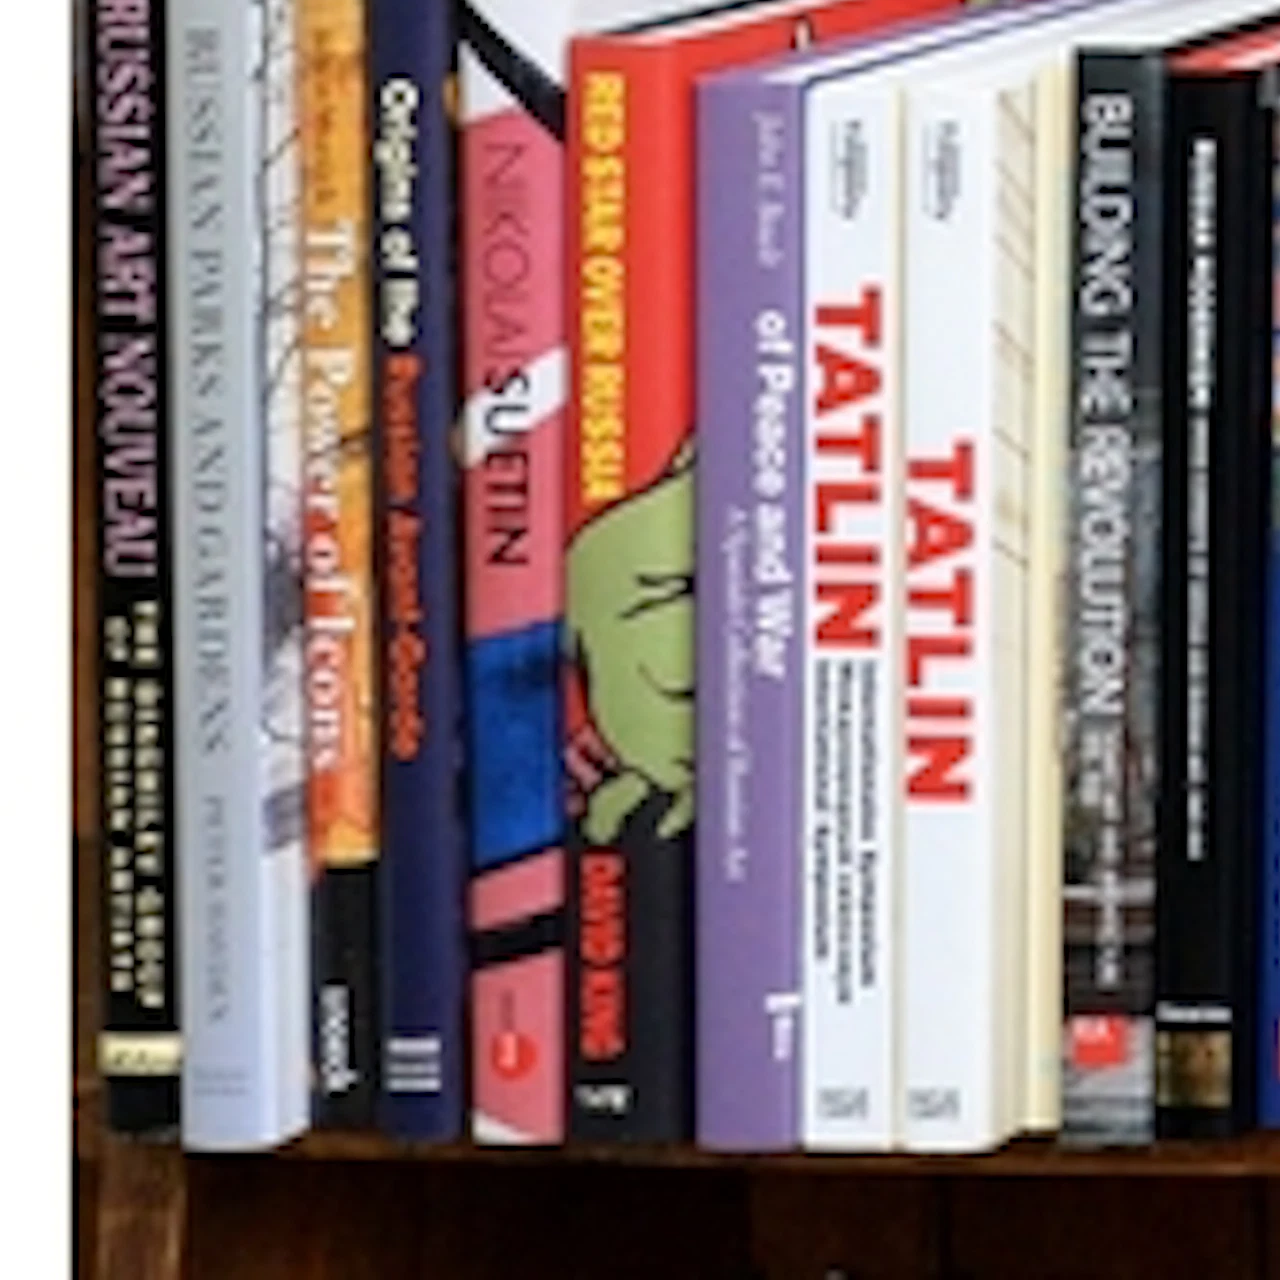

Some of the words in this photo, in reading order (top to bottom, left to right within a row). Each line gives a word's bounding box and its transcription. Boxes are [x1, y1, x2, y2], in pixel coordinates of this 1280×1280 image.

[186, 27, 226, 233] RUSSIAN
[376, 79, 421, 223] Origins
[582, 71, 627, 153] RED
[379, 229, 421, 271] of
[484, 142, 528, 363] NIKOLAI
[582, 155, 627, 252] STAR
[1080, 92, 1134, 318] BUILDING
[97, 223, 158, 325] ART
[186, 248, 228, 397] PARKS
[304, 218, 357, 331] The
[379, 278, 421, 347] the
[582, 257, 626, 361] OVER
[756, 310, 793, 353] of
[1080, 331, 1134, 417] THE
[99, 333, 158, 578] NOUVEAU
[190, 416, 230, 514] AND
[304, 347, 357, 517] Power
[484, 368, 529, 568] SUETIN
[755, 363, 793, 496] Peace
[813, 288, 883, 649] TATLIN
[306, 534, 358, 602] of
[756, 503, 793, 583] and
[1078, 423, 1132, 716] REVOLUTION
[190, 523, 231, 756] GARDENS
[756, 589, 793, 680] War
[906, 441, 976, 804] TATLIN
[306, 612, 357, 770] Icons
[579, 853, 626, 965] DAVID
[579, 969, 626, 1057] KING
